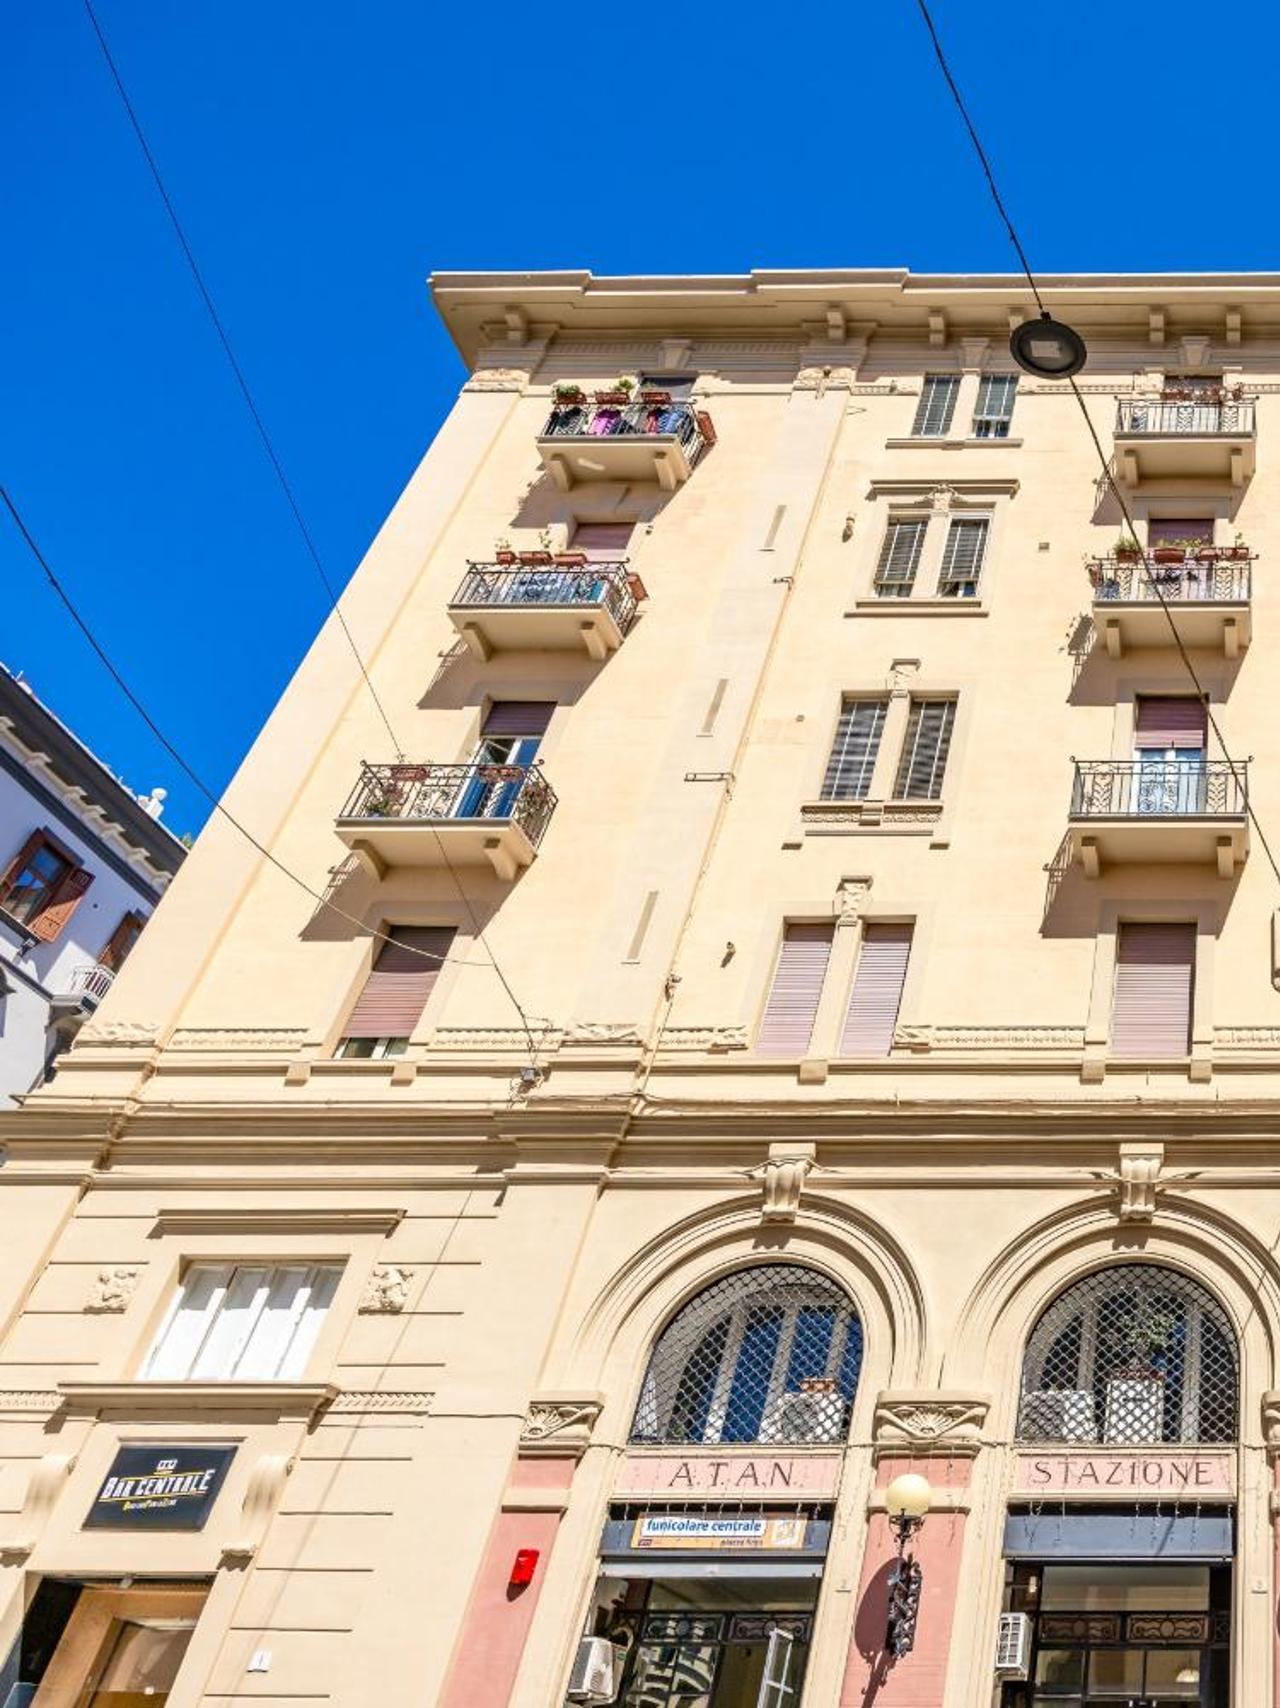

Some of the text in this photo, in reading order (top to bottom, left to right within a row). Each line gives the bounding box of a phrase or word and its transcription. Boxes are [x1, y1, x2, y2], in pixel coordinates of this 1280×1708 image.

[135, 1468, 216, 1496] CENTRALE
[1032, 1460, 1214, 1486] STAZIONE
[646, 1519, 762, 1532] funicolare centrale
